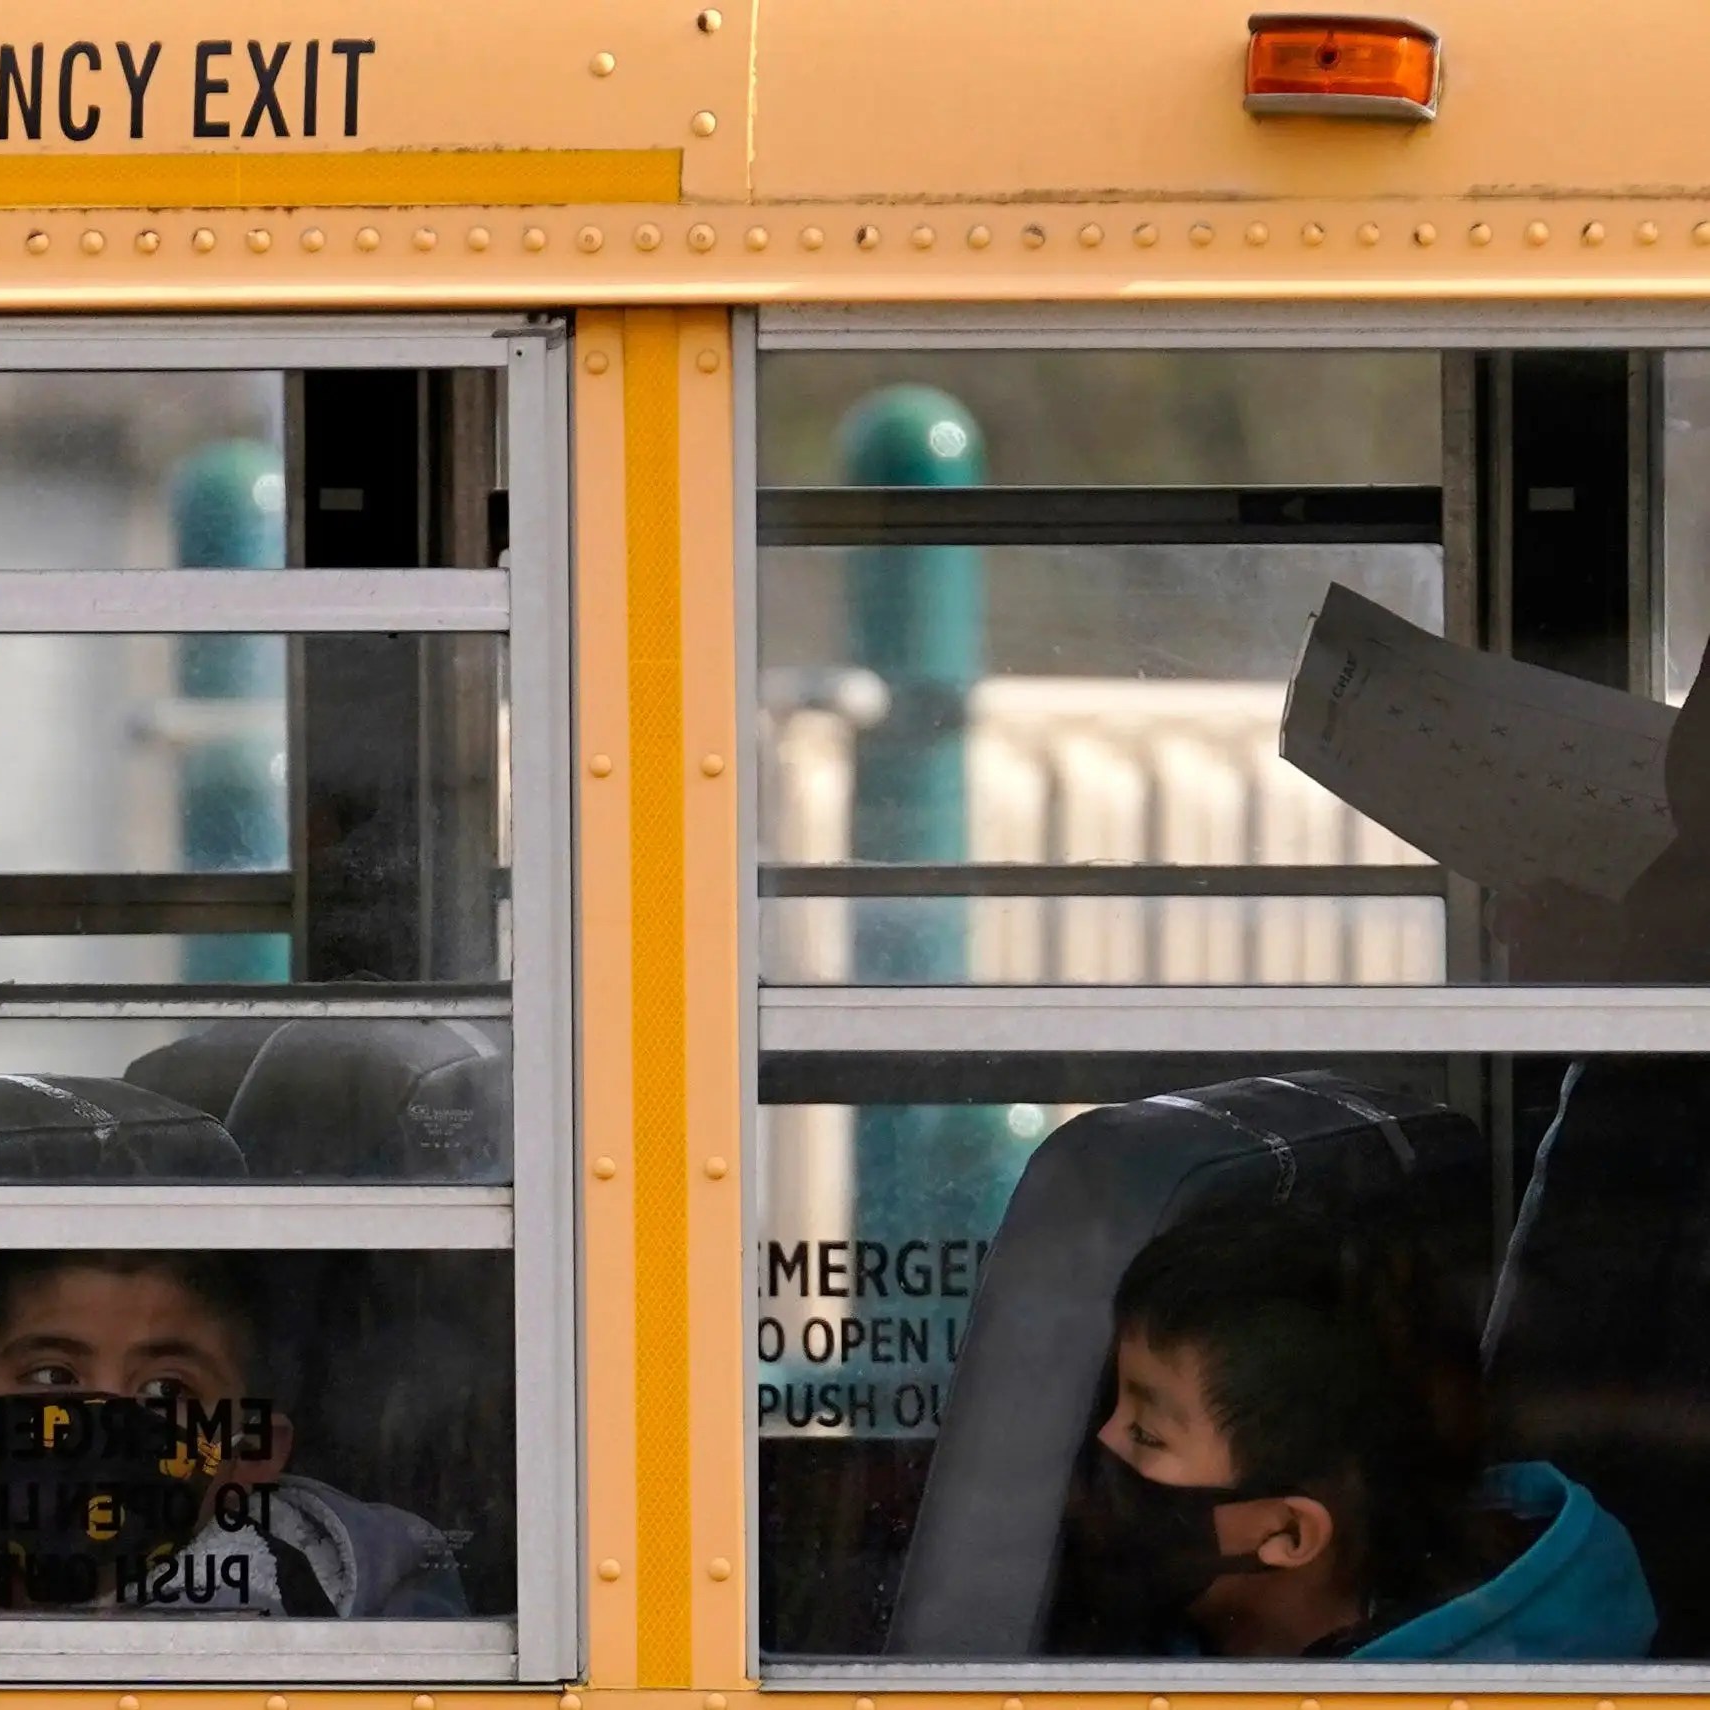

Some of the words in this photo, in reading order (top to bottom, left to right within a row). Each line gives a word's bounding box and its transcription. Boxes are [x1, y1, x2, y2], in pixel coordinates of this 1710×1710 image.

[192, 39, 376, 139] EXIT
[758, 1239, 988, 1297] MERGE
[802, 1315, 929, 1364] OPEN
[758, 1382, 877, 1429] PUSH
